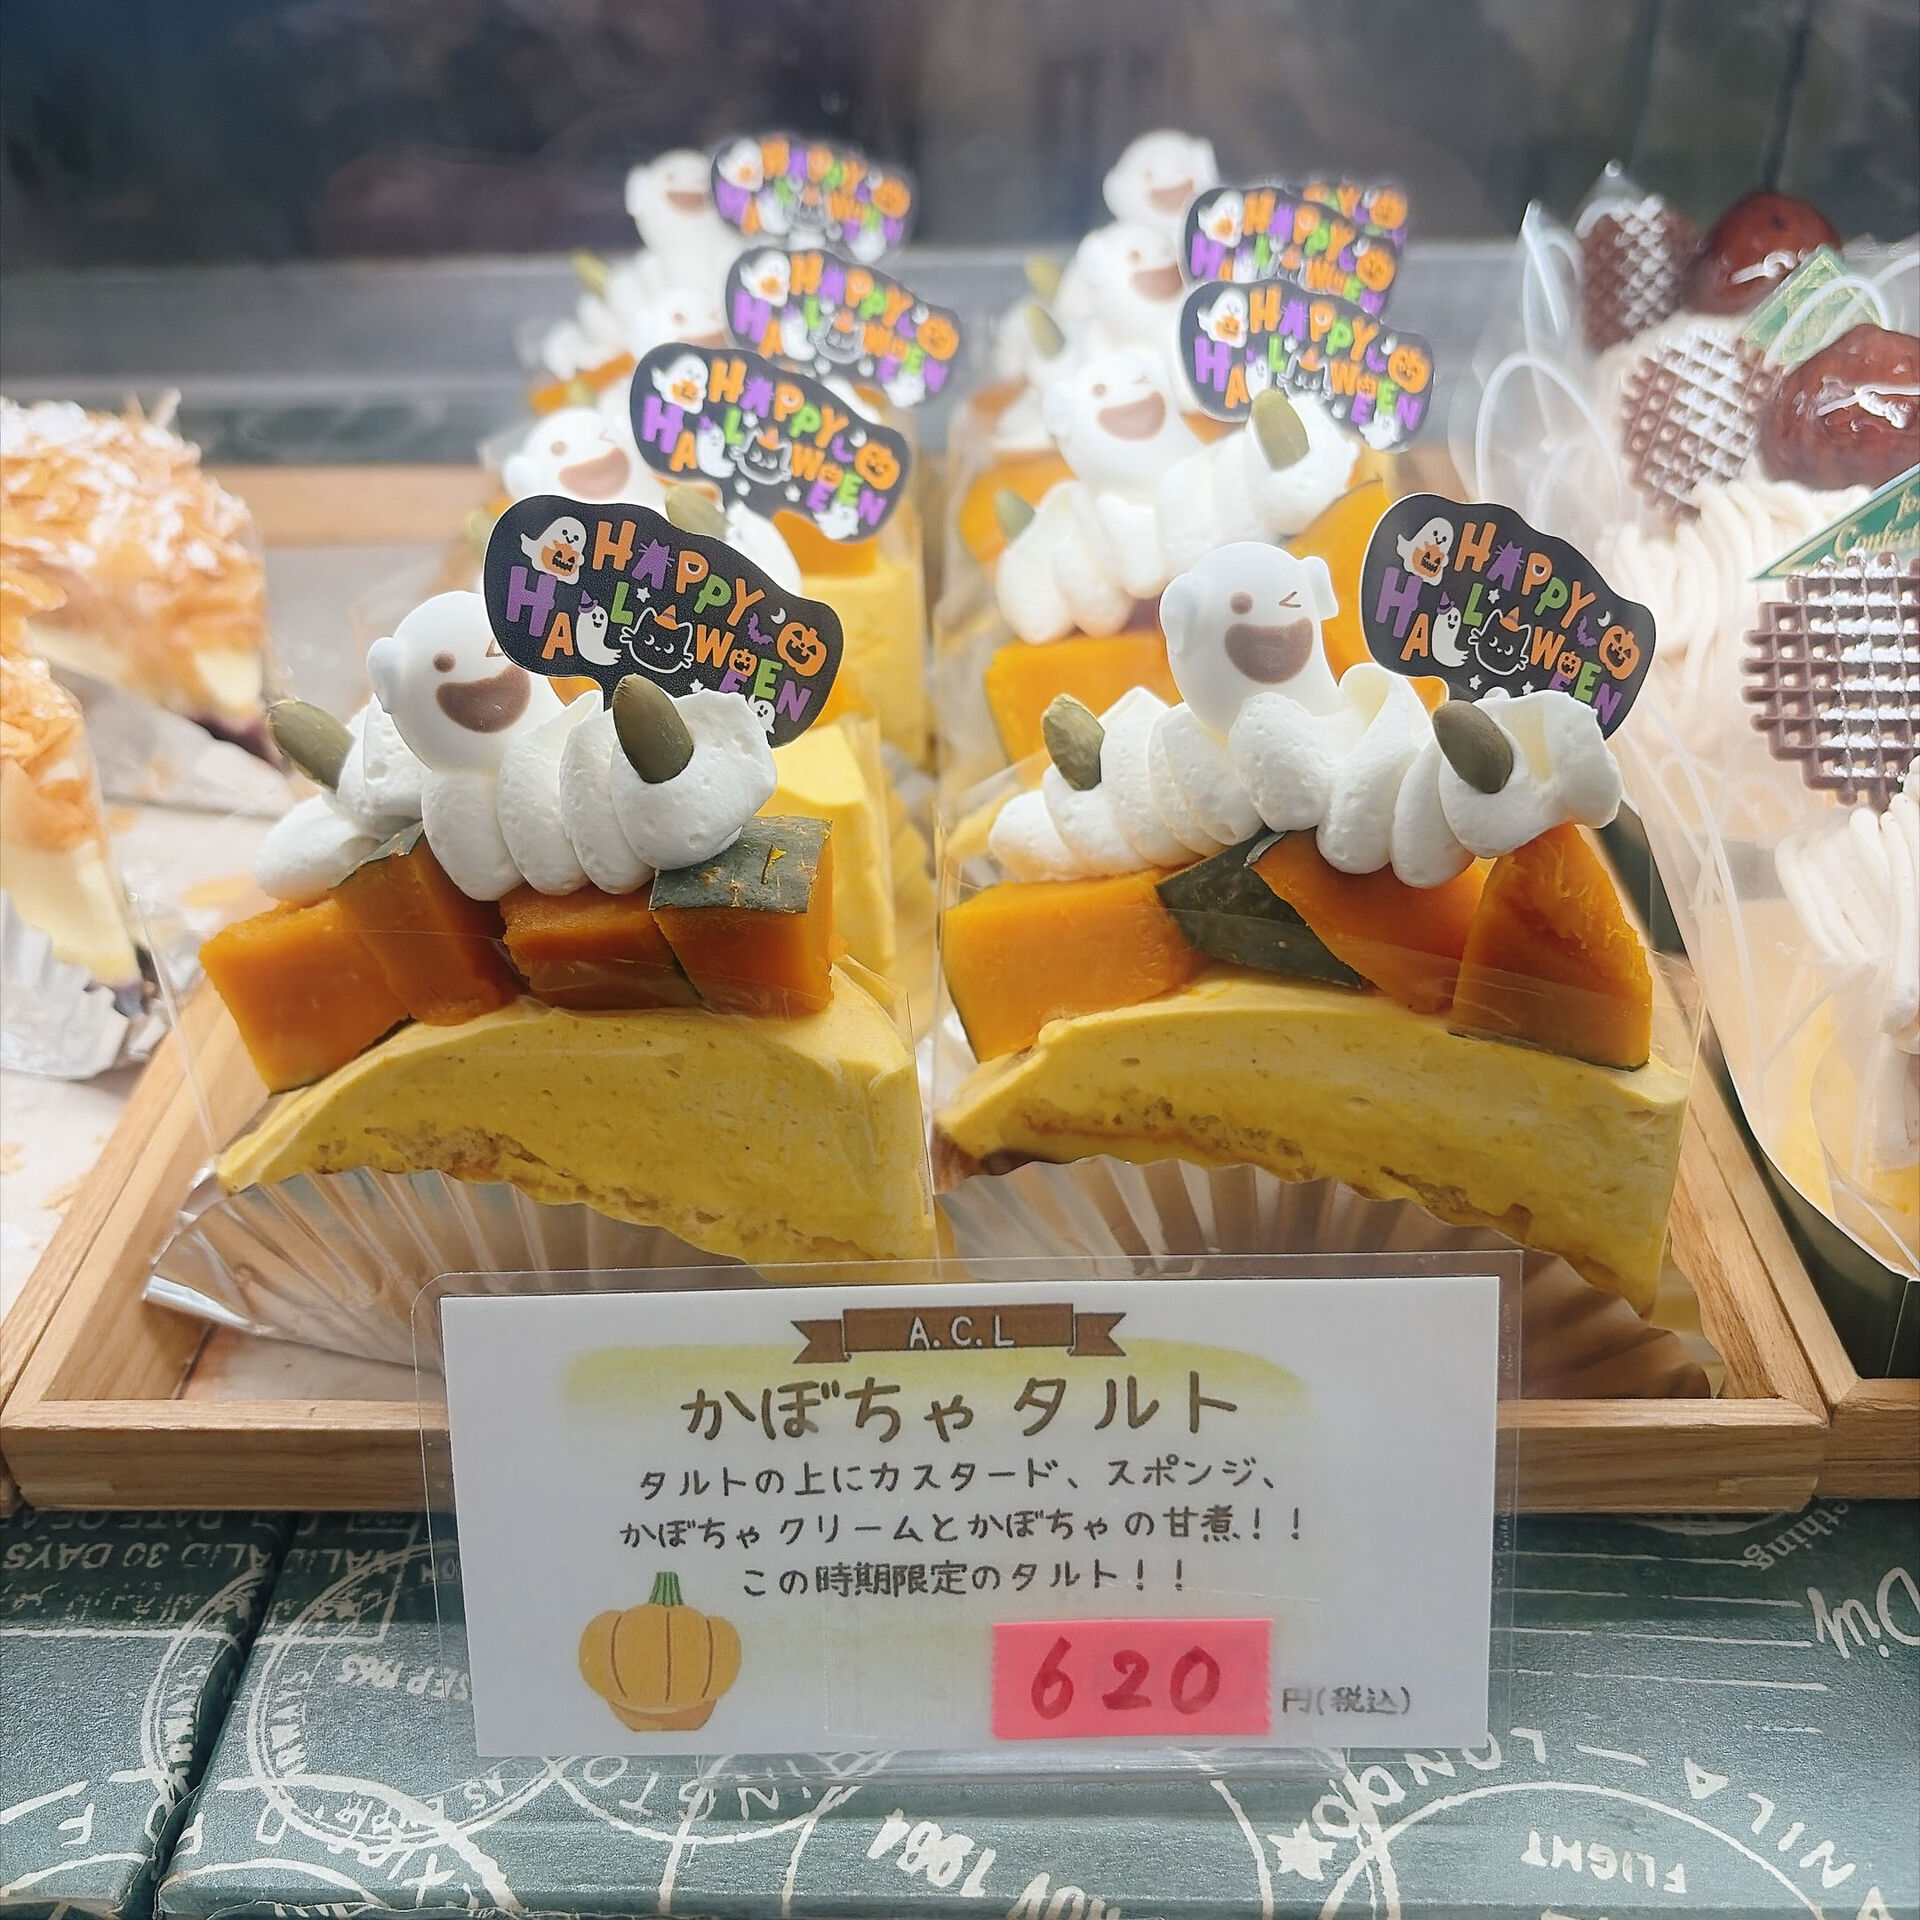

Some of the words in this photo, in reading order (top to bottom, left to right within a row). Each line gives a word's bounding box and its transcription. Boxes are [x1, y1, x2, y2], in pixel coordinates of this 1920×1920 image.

[708, 357, 849, 448] HAPPY
[593, 520, 765, 627] HAPPY
[1454, 521, 1596, 629] HAPPY
[1030, 1636, 1221, 1719] 620
[1519, 1829, 1688, 1894] FLIGHT
